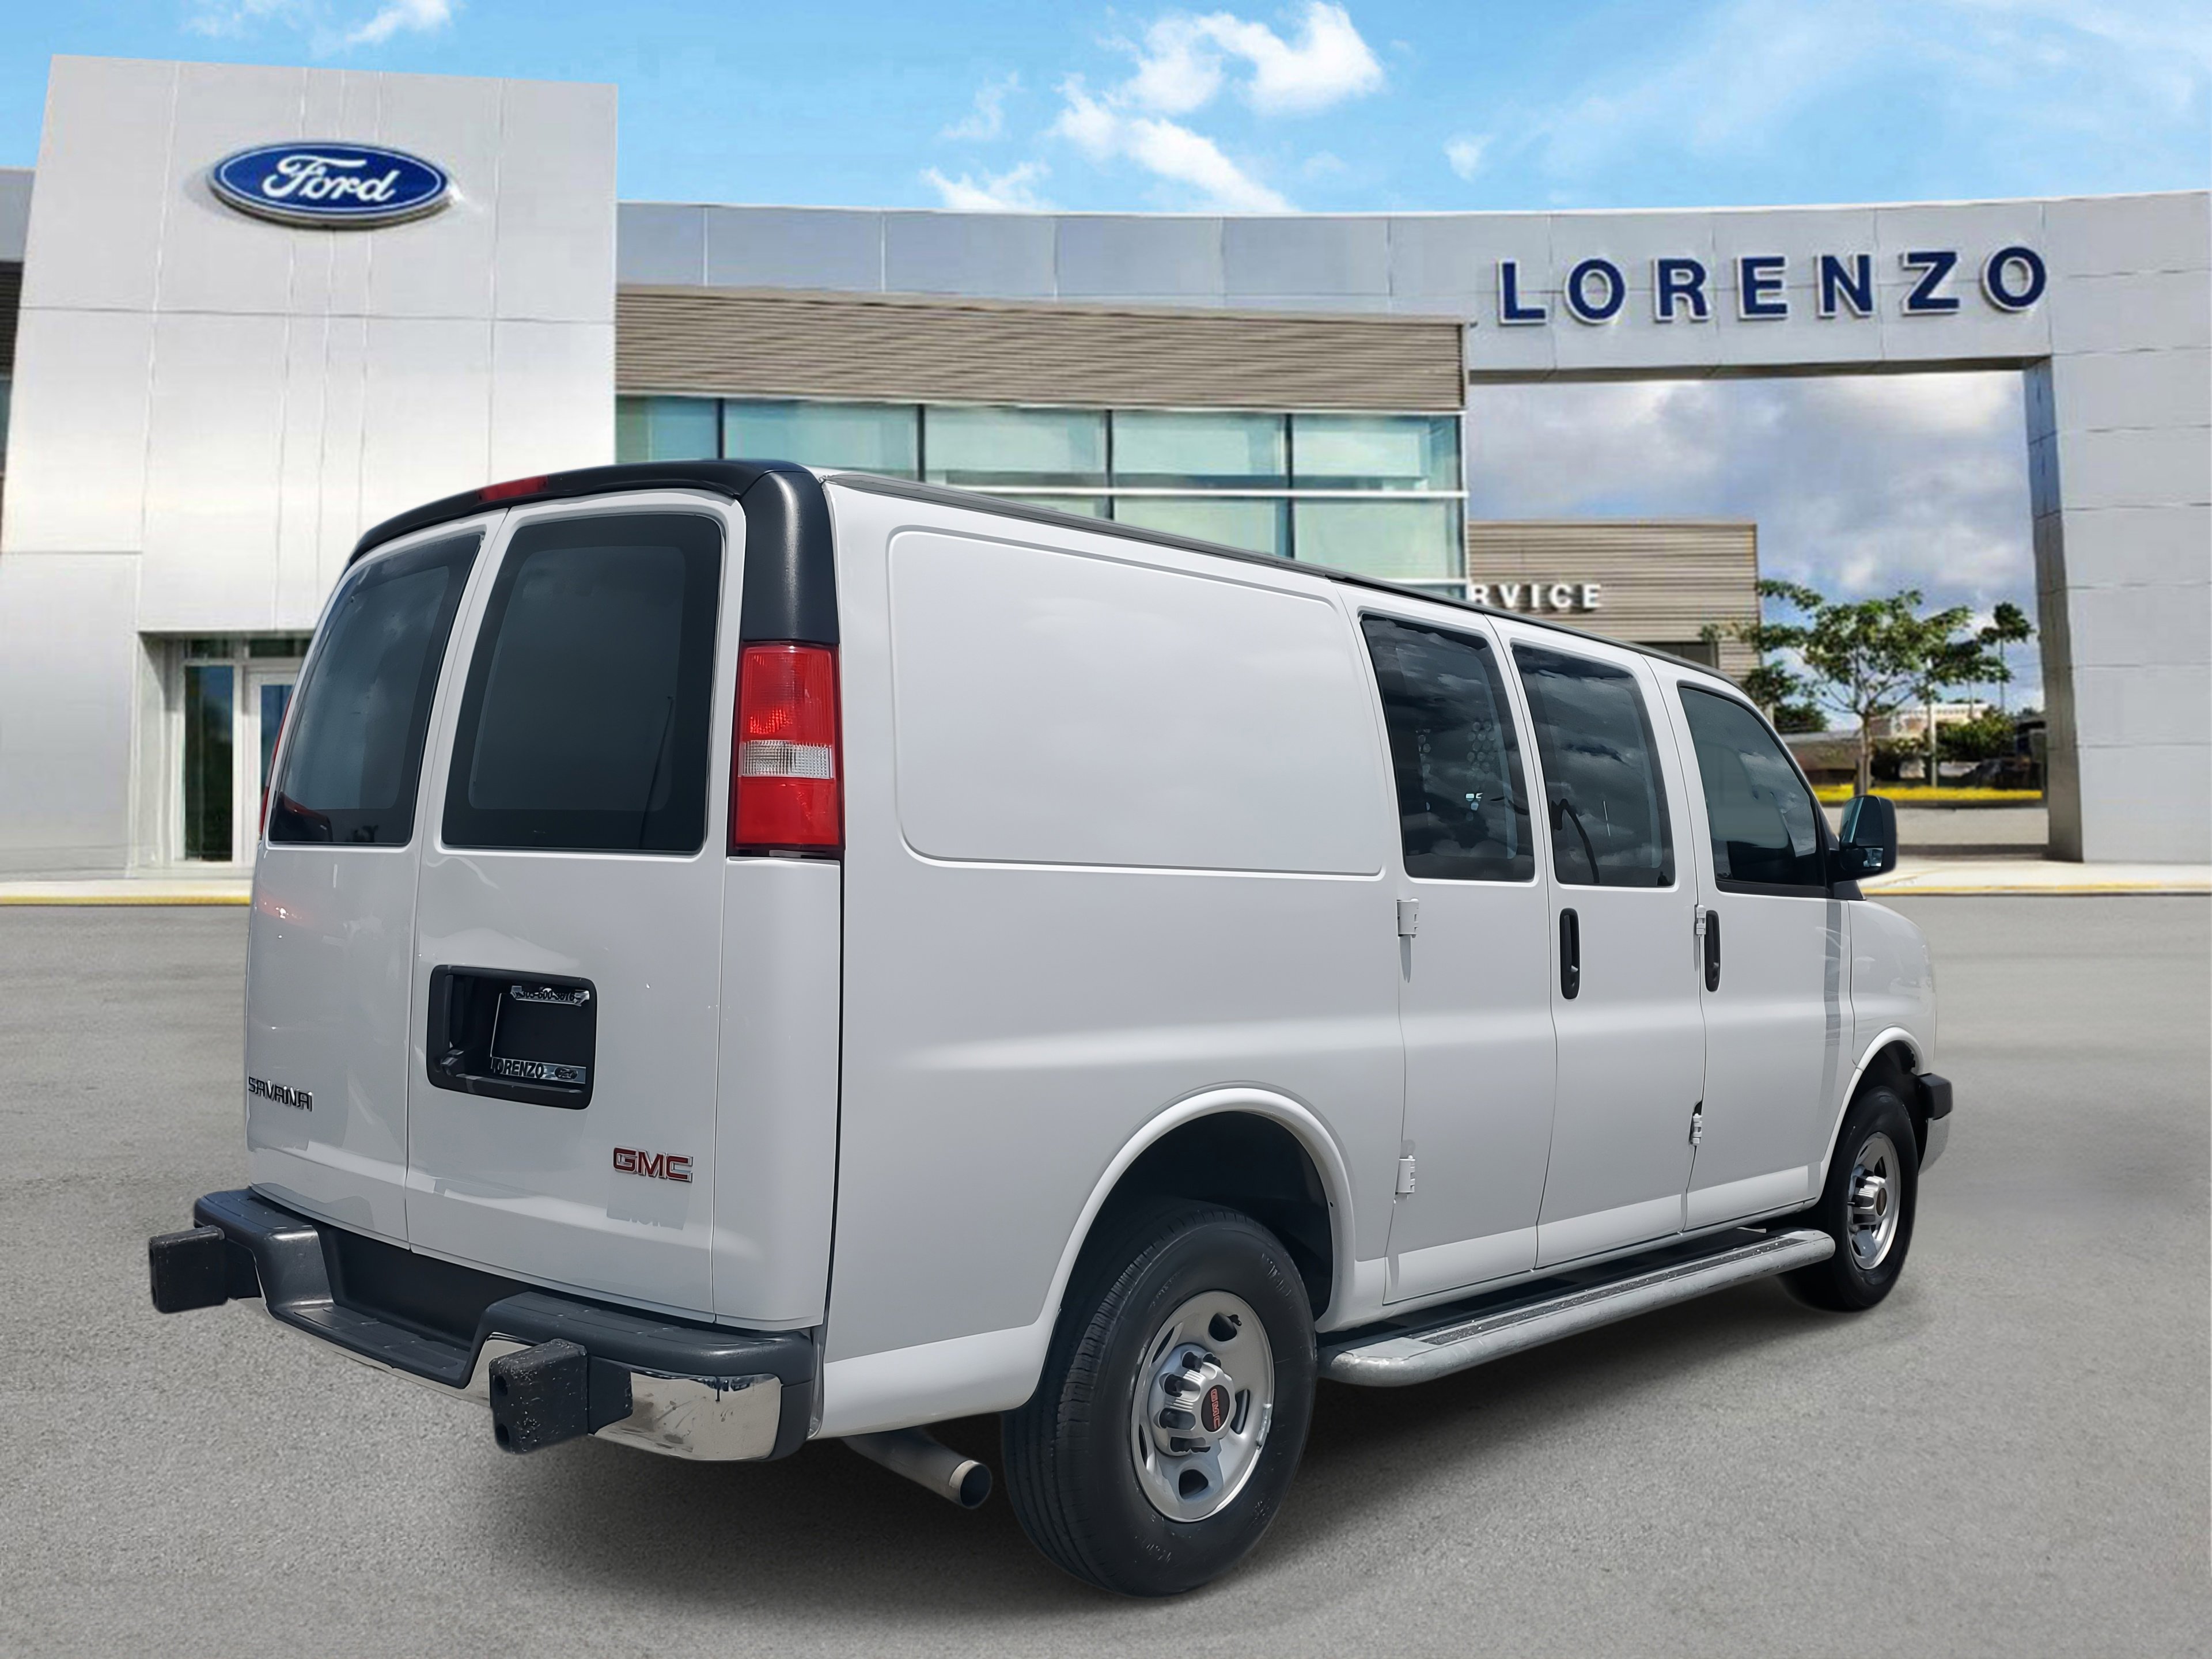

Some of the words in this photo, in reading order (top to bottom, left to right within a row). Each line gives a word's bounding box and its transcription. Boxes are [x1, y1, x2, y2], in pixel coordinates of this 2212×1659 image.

[262, 154, 400, 201] Ford
[1498, 245, 2047, 325] LORENZO
[493, 1058, 545, 1078] LORENZO
[249, 1076, 313, 1112] SAVANA
[613, 1146, 693, 1183] GMC
[1210, 1388, 1221, 1429] GMC
